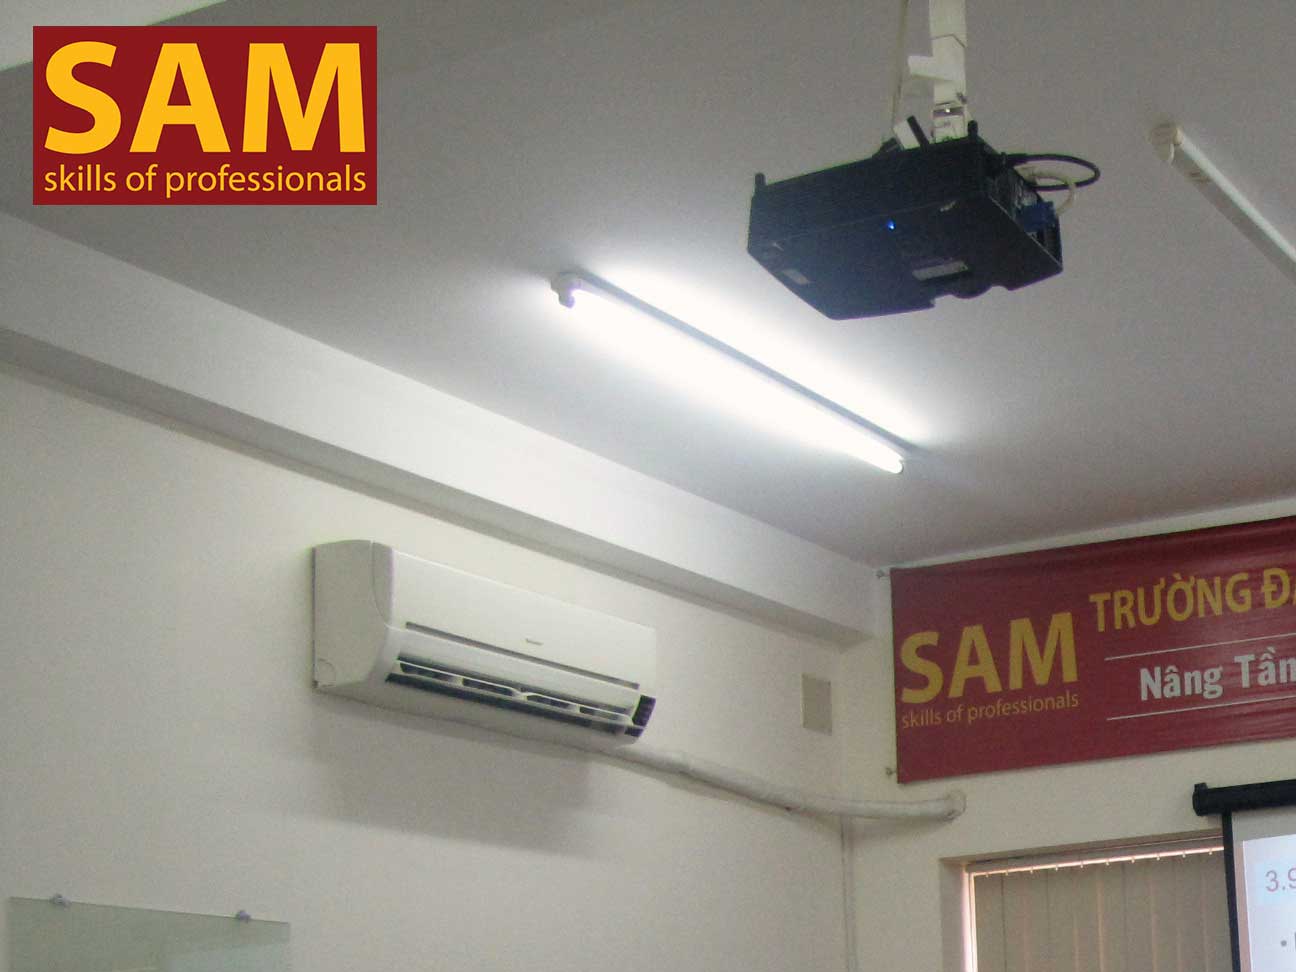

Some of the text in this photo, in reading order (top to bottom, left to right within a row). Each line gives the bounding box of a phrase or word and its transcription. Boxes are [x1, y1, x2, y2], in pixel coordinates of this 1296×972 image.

[1090, 572, 1252, 632] TRƯỜNG
[901, 612, 1079, 704] SAM
[1139, 667, 1224, 702] Nâng
[902, 691, 1080, 730] skills of professionals
